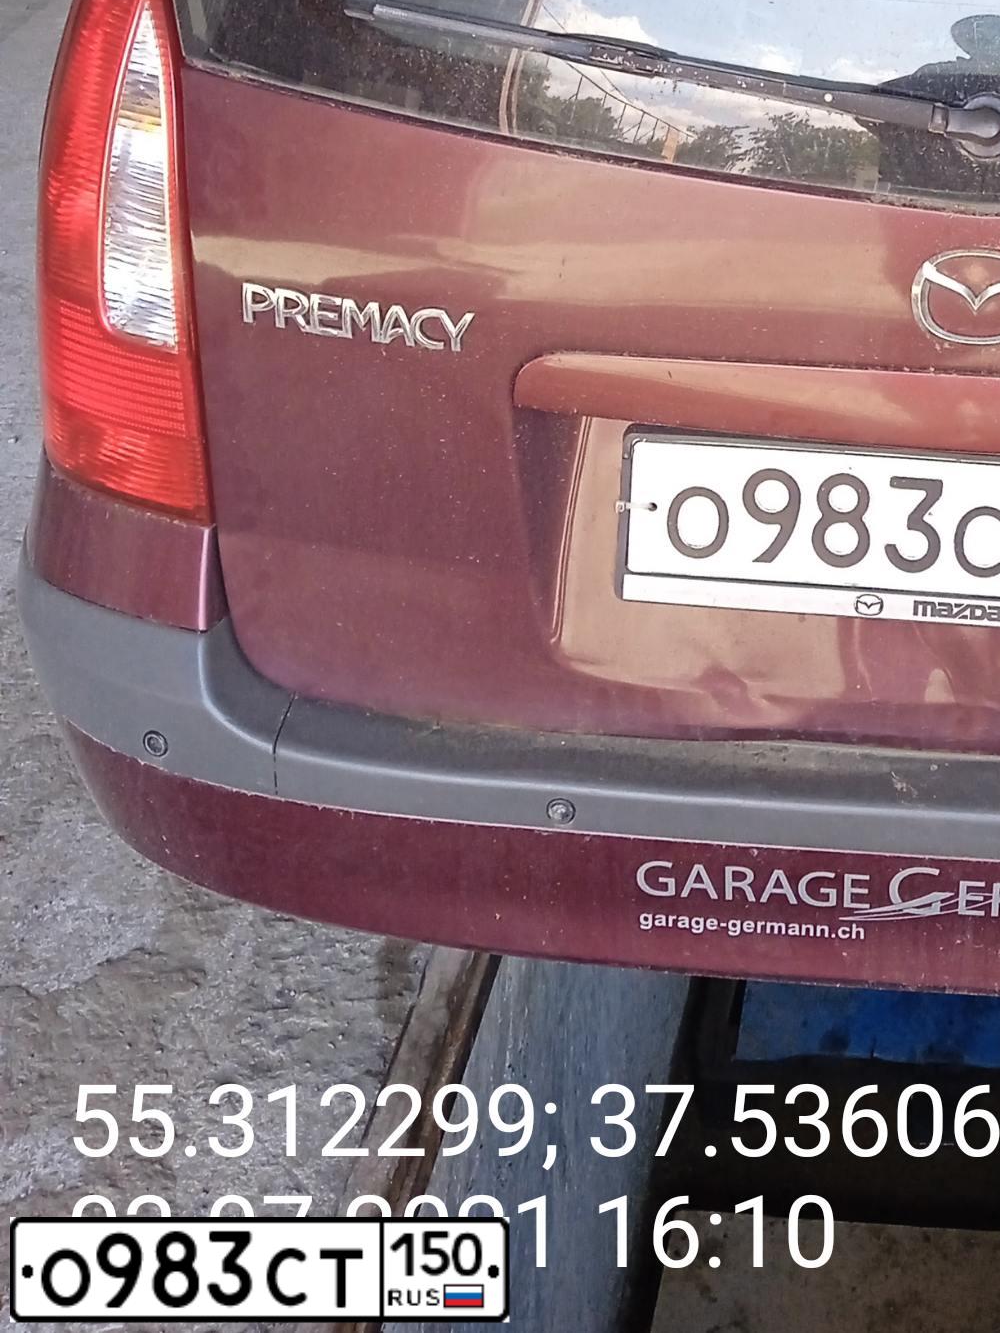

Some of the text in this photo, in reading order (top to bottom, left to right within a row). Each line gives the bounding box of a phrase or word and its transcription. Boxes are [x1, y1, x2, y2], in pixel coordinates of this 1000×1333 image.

[241, 282, 476, 353] PREMACY
[635, 860, 871, 911] GARAGE
[638, 912, 866, 941] garage-germann.ch
